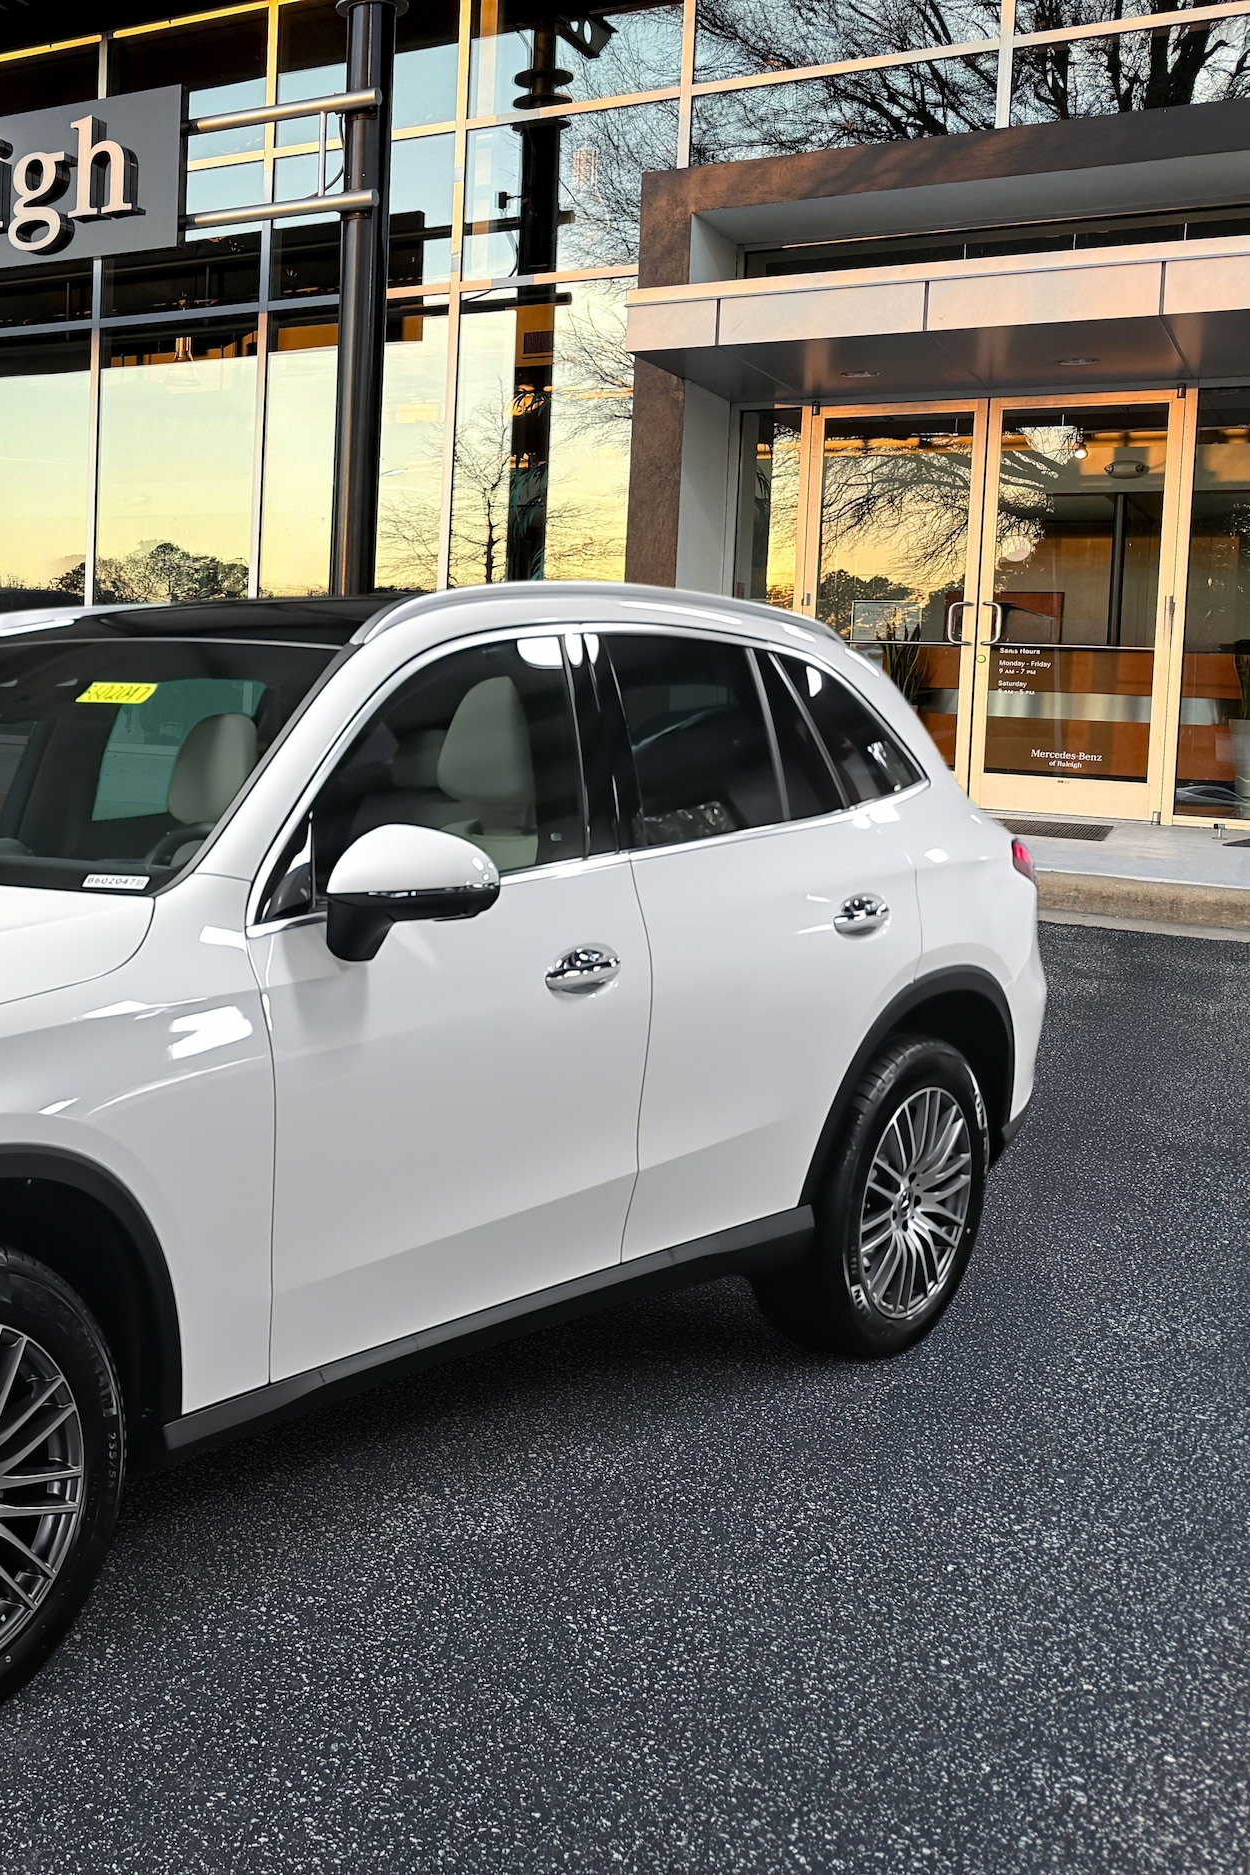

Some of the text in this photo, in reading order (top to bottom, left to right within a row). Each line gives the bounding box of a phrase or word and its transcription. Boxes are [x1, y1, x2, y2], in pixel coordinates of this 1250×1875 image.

[998, 660, 1025, 668] Monday
[998, 680, 1027, 688] Saturday
[1030, 749, 1103, 762] Mercedes-Benz
[1057, 761, 1082, 769] Raleigh
